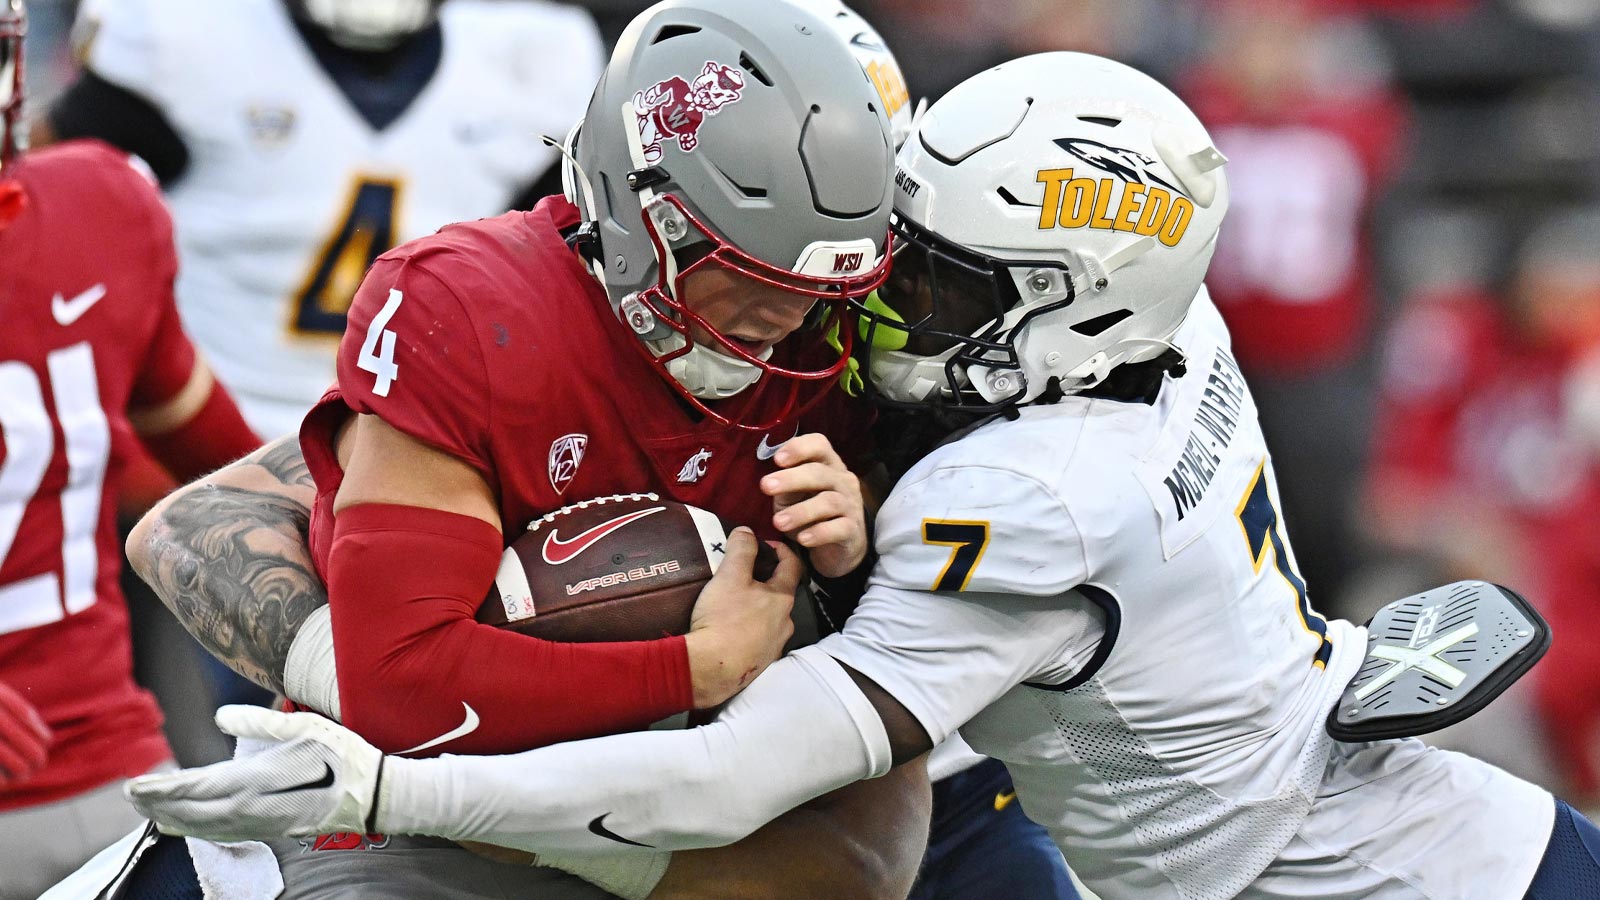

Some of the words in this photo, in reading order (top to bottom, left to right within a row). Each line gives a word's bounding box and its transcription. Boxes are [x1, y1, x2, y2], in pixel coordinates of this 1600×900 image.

[902, 173, 921, 199] CITY
[1036, 168, 1195, 248] TOLEDO
[833, 252, 864, 272] WSU
[357, 288, 403, 397] 4
[554, 459, 574, 483] 12
[921, 516, 991, 592] 7
[566, 572, 629, 596] VAPOR
[627, 560, 680, 581] ELITE
